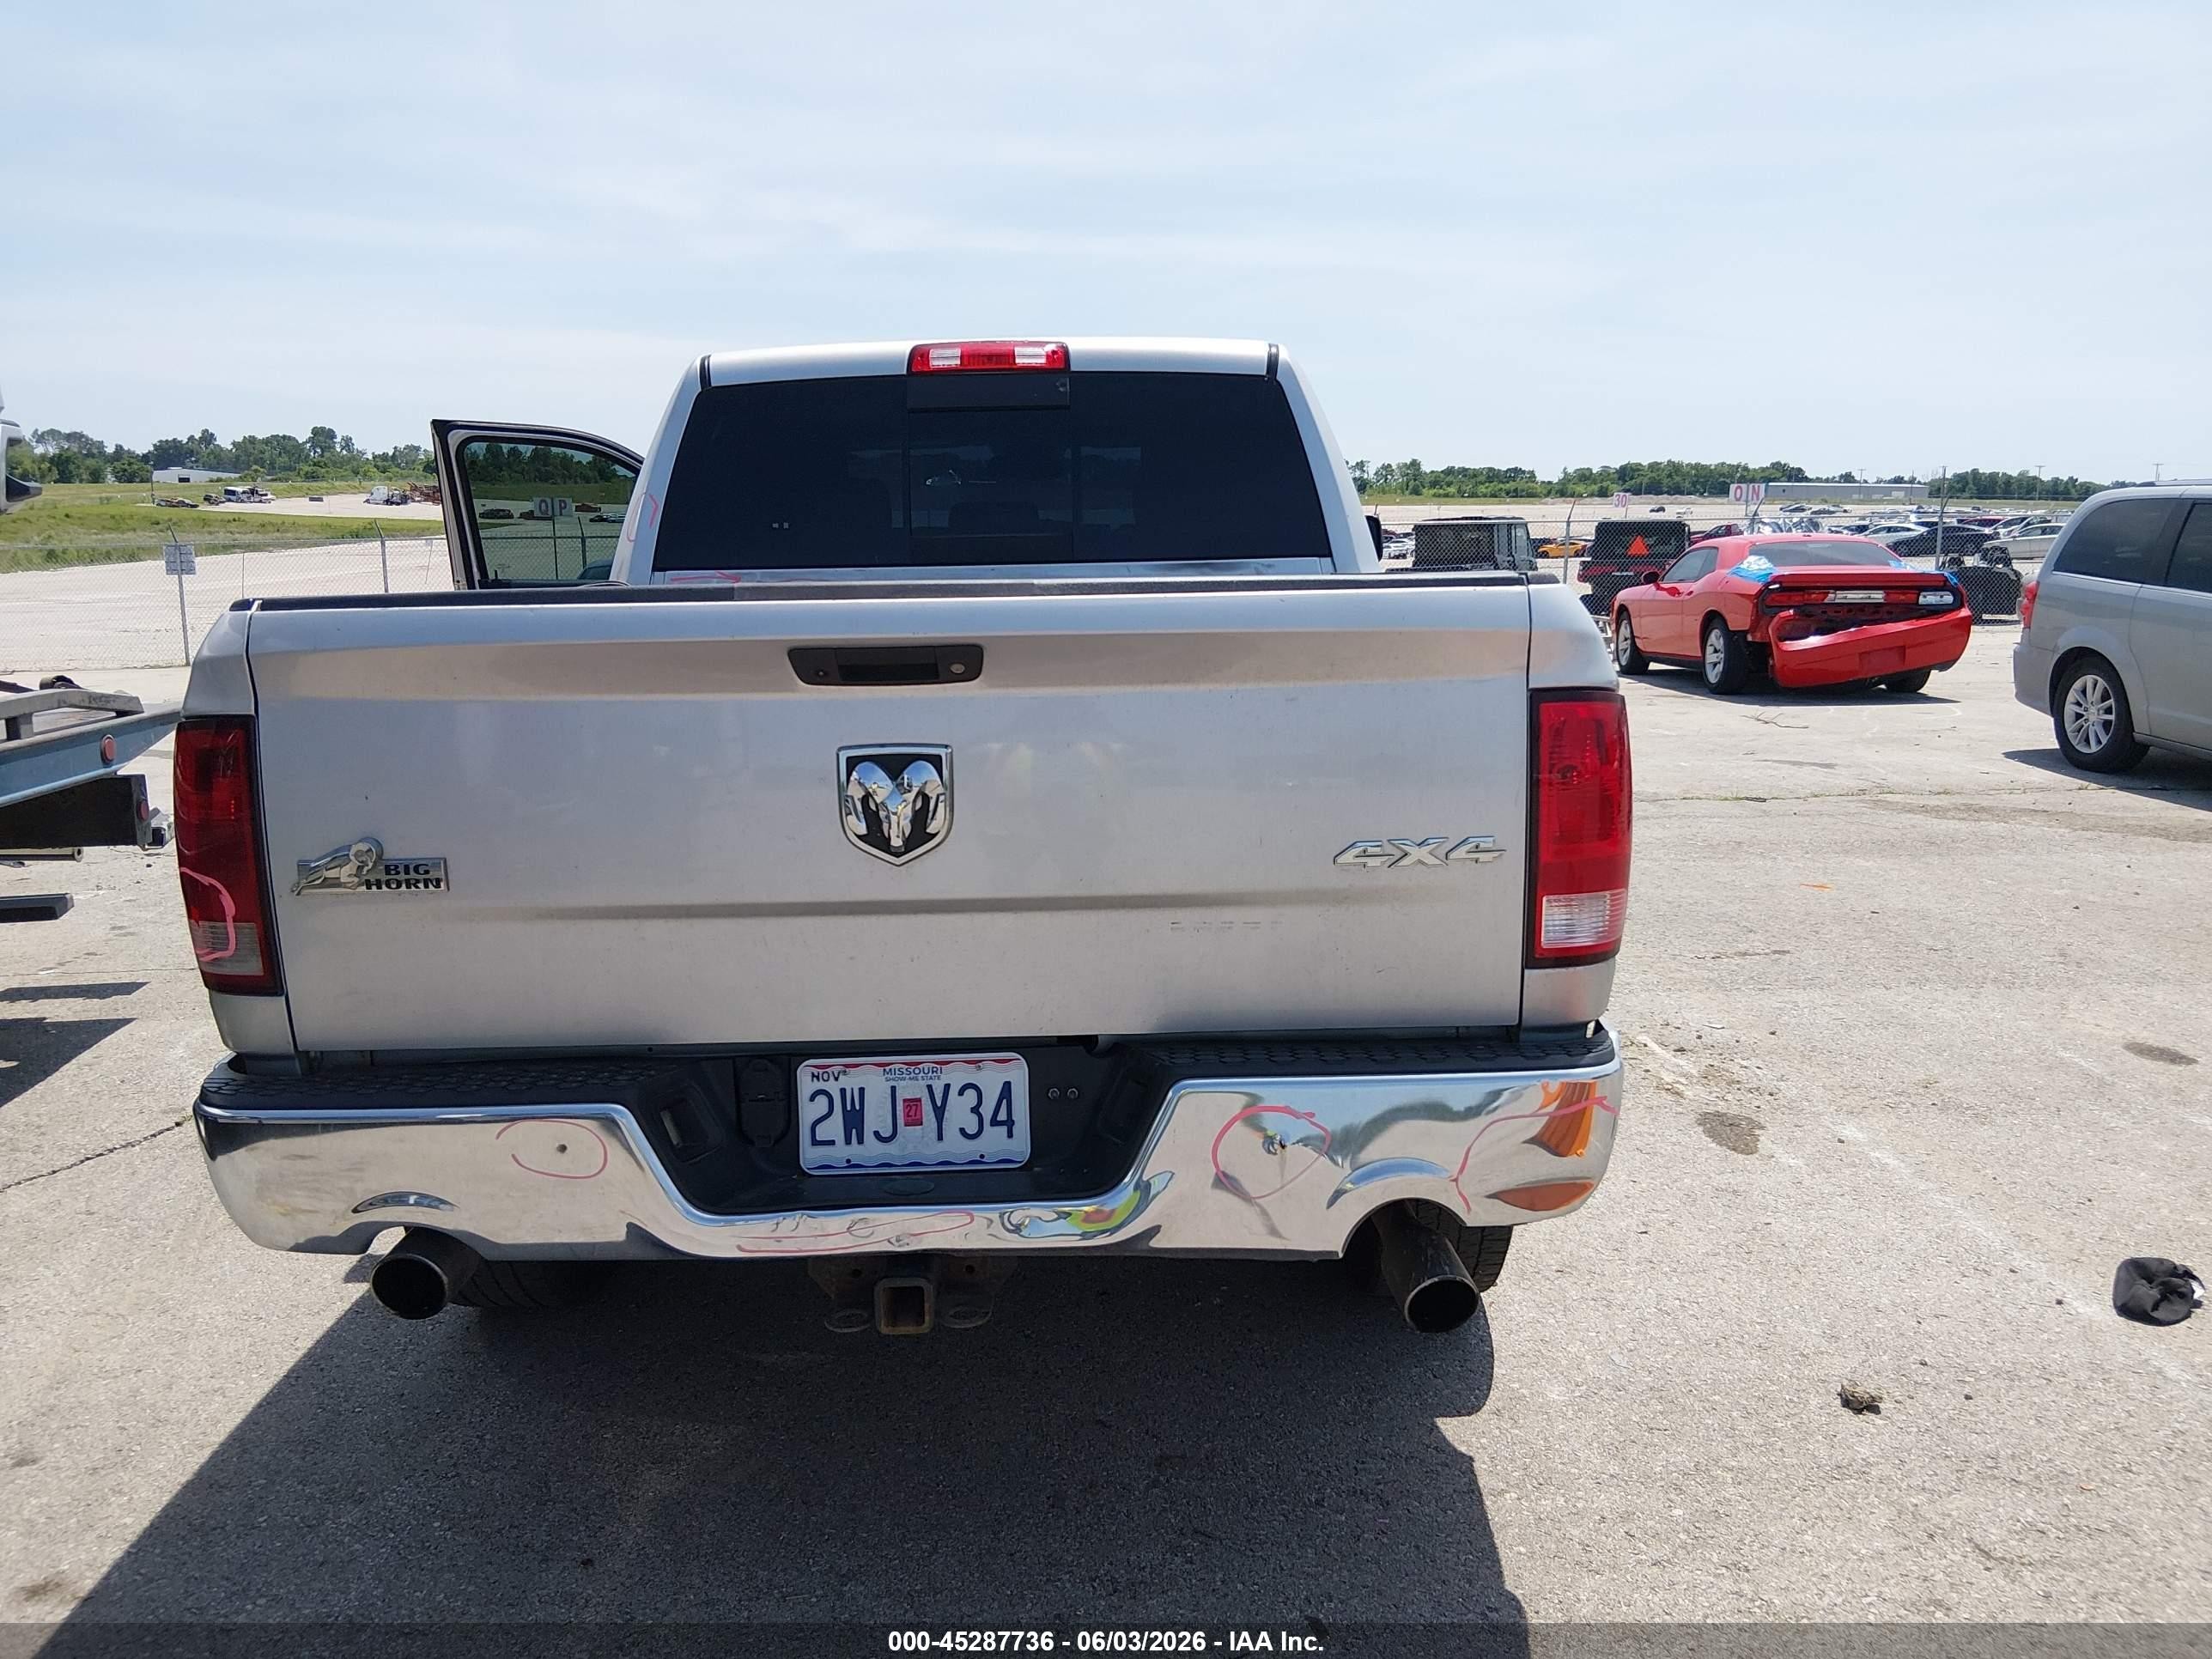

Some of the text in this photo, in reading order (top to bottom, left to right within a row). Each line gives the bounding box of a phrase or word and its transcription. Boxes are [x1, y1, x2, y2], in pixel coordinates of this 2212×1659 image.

[1614, 494, 1627, 507] 30
[538, 499, 568, 516] Q P
[1334, 836, 1507, 869] 4X4
[384, 864, 430, 876] BIG
[365, 878, 442, 890] HORN
[811, 1071, 841, 1082] NOV
[883, 1066, 943, 1076] MISSOURI
[906, 1103, 919, 1118] 27
